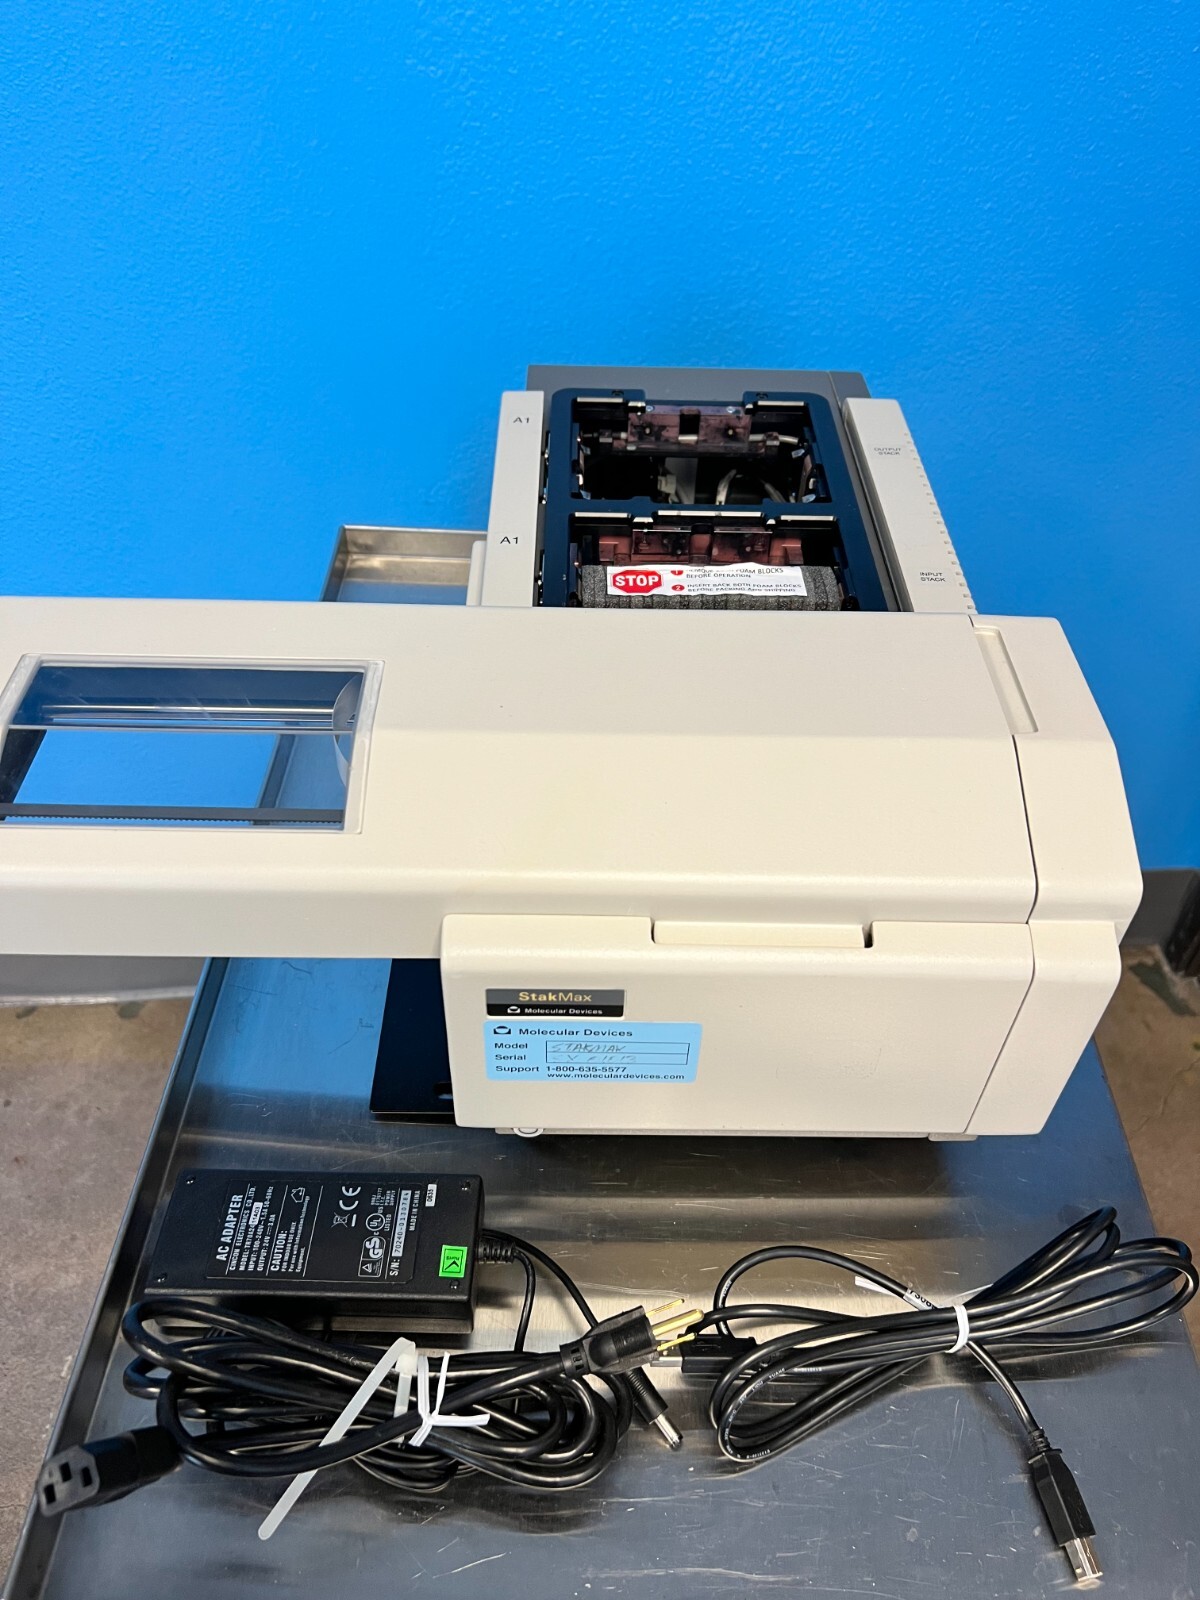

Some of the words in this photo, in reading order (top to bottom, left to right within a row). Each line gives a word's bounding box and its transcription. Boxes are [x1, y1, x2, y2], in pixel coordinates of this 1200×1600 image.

[512, 416, 530, 424] A1
[500, 536, 519, 544] A1
[615, 575, 660, 587] STOP
[519, 992, 592, 1002] StakMax
[519, 1028, 580, 1036] Molecular
[584, 1029, 633, 1037] Devices
[496, 1065, 540, 1073] Support
[546, 1065, 627, 1073] 1-800-635-5577
[547, 1072, 685, 1080] www.moleculardevices.com
[220, 1195, 243, 1243] ADAPTER
[384, 1214, 392, 1231] LISTED
[409, 1215, 417, 1230] MADE
[236, 1210, 250, 1246] ELECTRONICS
[216, 1246, 230, 1261] AC
[271, 1230, 287, 1271] CAUTION:
[366, 1237, 383, 1258] GS
[239, 1249, 249, 1270] MODEL:
[248, 1252, 258, 1271] INPUT:
[257, 1247, 267, 1271] OUTPUT:
[390, 1259, 400, 1276] S/N:
